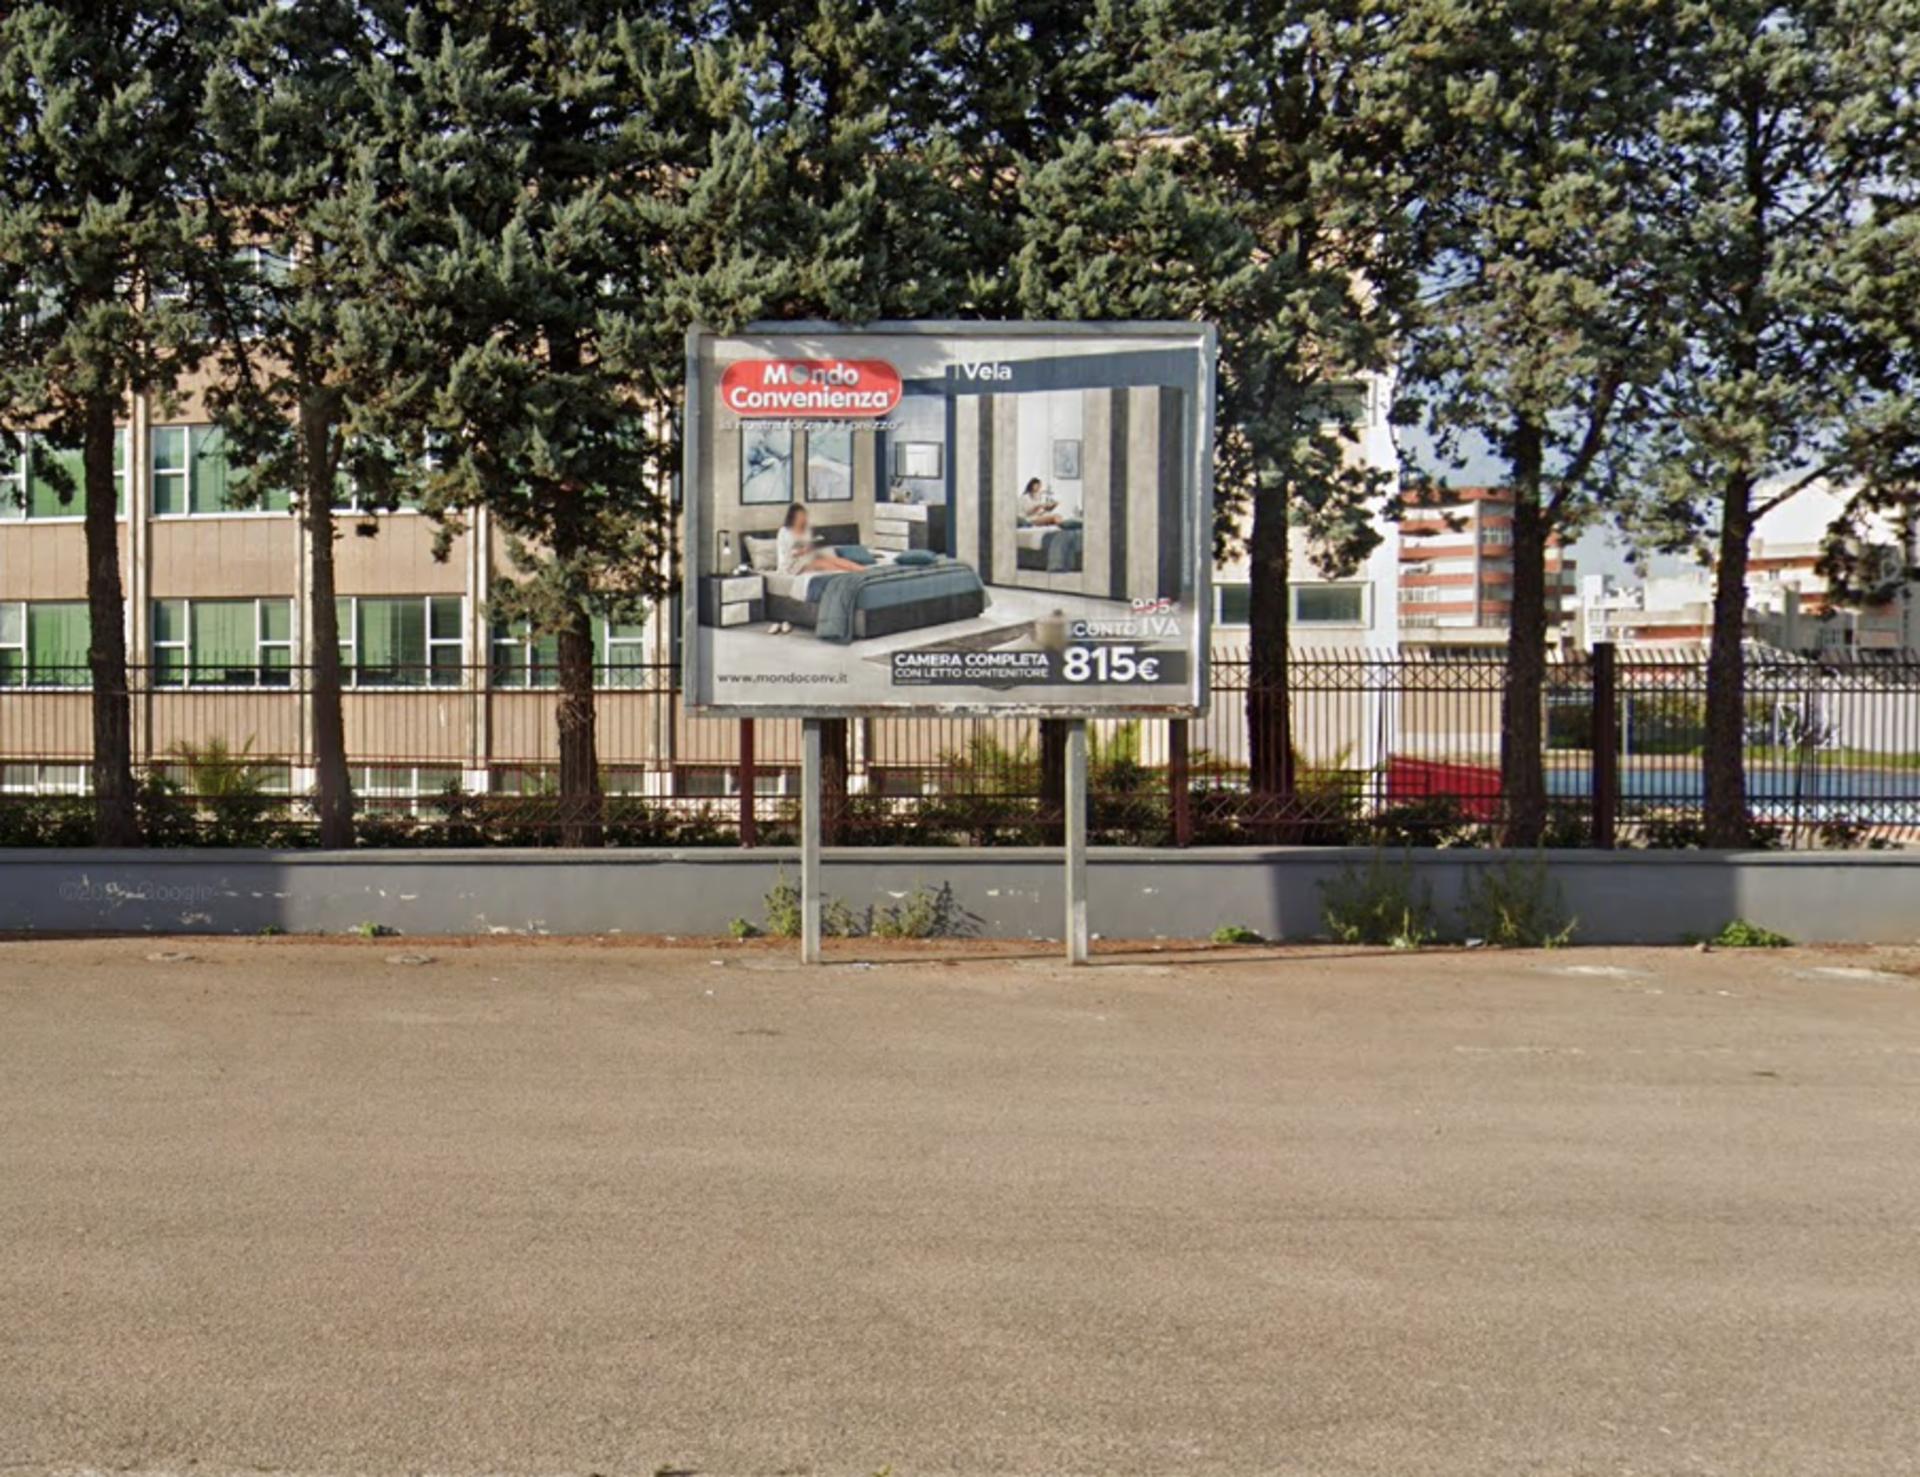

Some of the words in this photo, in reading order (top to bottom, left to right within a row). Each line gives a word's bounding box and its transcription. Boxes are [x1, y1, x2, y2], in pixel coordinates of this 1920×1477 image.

[763, 364, 859, 385] Mondo
[962, 362, 1012, 380] Vela
[731, 386, 888, 408] Convenienza
[1143, 617, 1181, 636] IVA
[895, 653, 962, 667] CAMERA
[965, 653, 1049, 667] COMPLETA
[1062, 646, 1160, 681] 815€
[717, 672, 848, 685] www.mondoconv.it
[895, 667, 921, 678] CON
[925, 667, 961, 678] LETTO
[964, 667, 1049, 678] CONTENITORE
